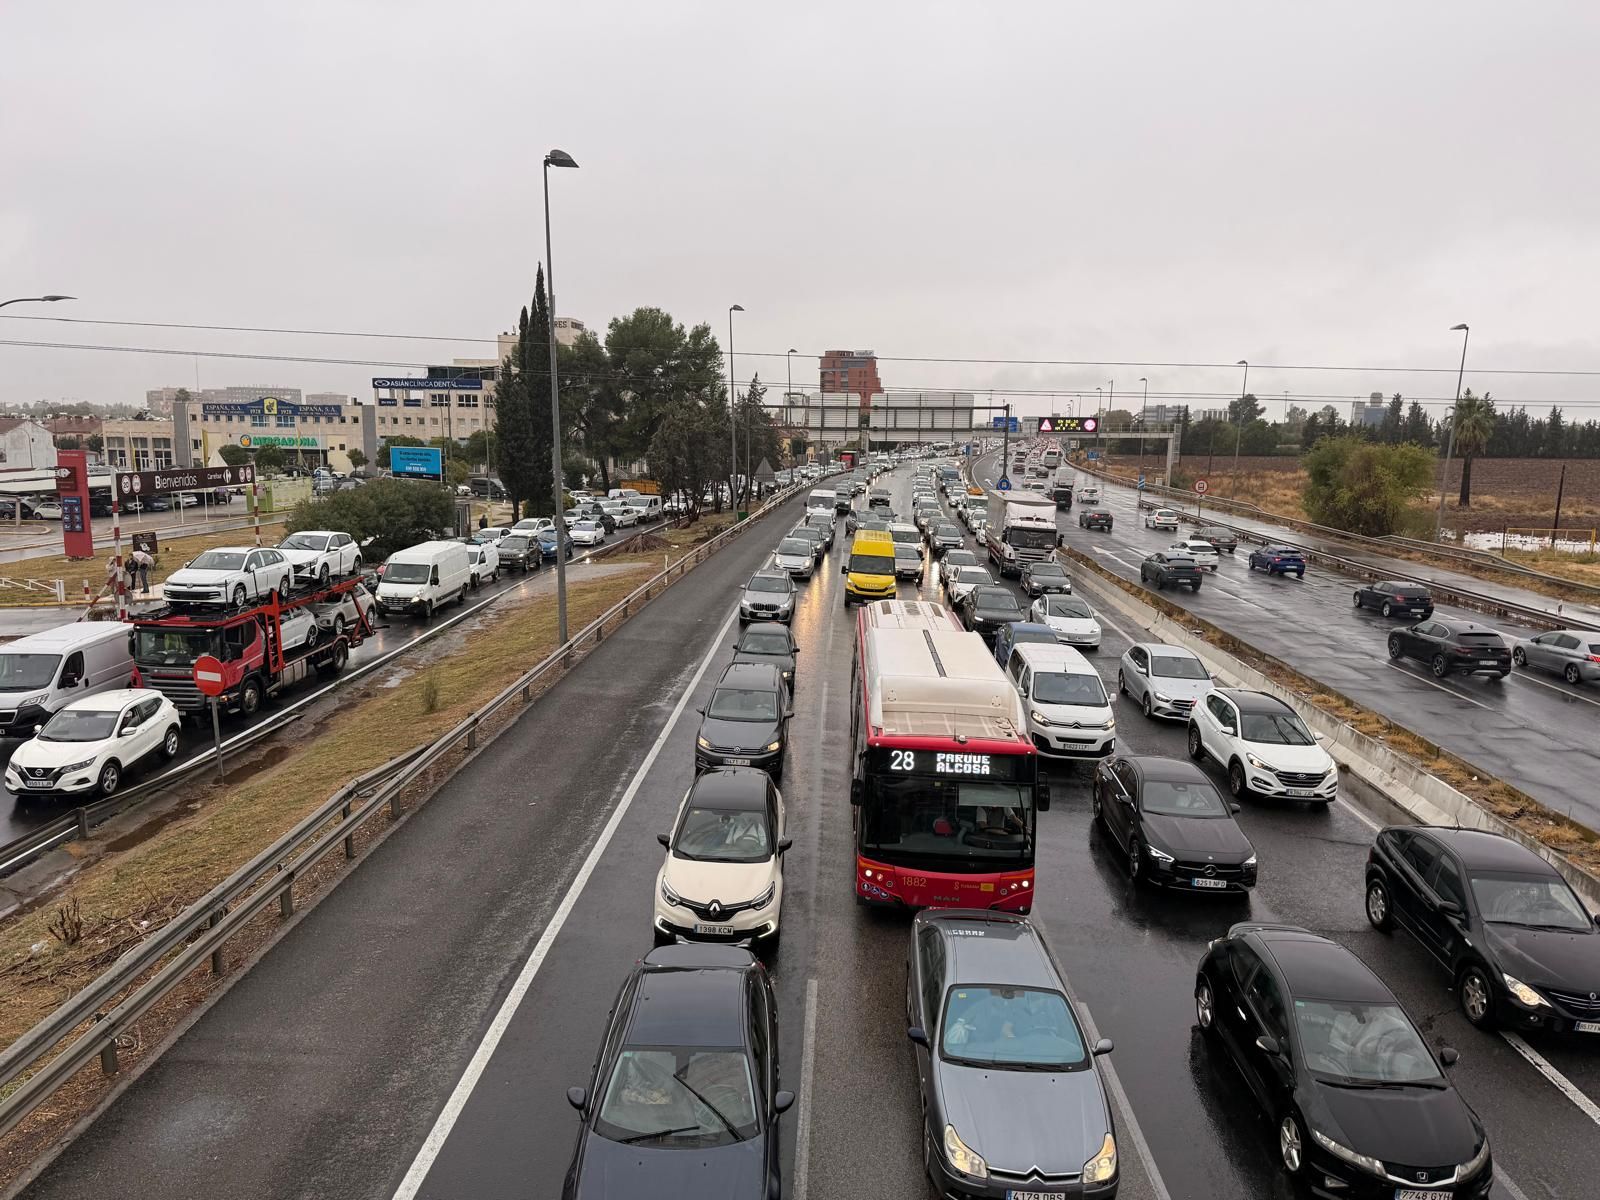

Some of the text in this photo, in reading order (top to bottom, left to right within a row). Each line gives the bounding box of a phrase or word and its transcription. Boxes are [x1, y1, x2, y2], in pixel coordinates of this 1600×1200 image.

[409, 380, 433, 388] CLÍNICA
[252, 436, 318, 447] MERCADONA
[154, 474, 198, 489] Bienvenidos
[890, 750, 915, 770] 28
[936, 762, 991, 775] ALCOSA
[902, 876, 927, 888] 1882
[700, 925, 732, 934] 1398 KCM
[1402, 1190, 1451, 1200] 7748 GYH
